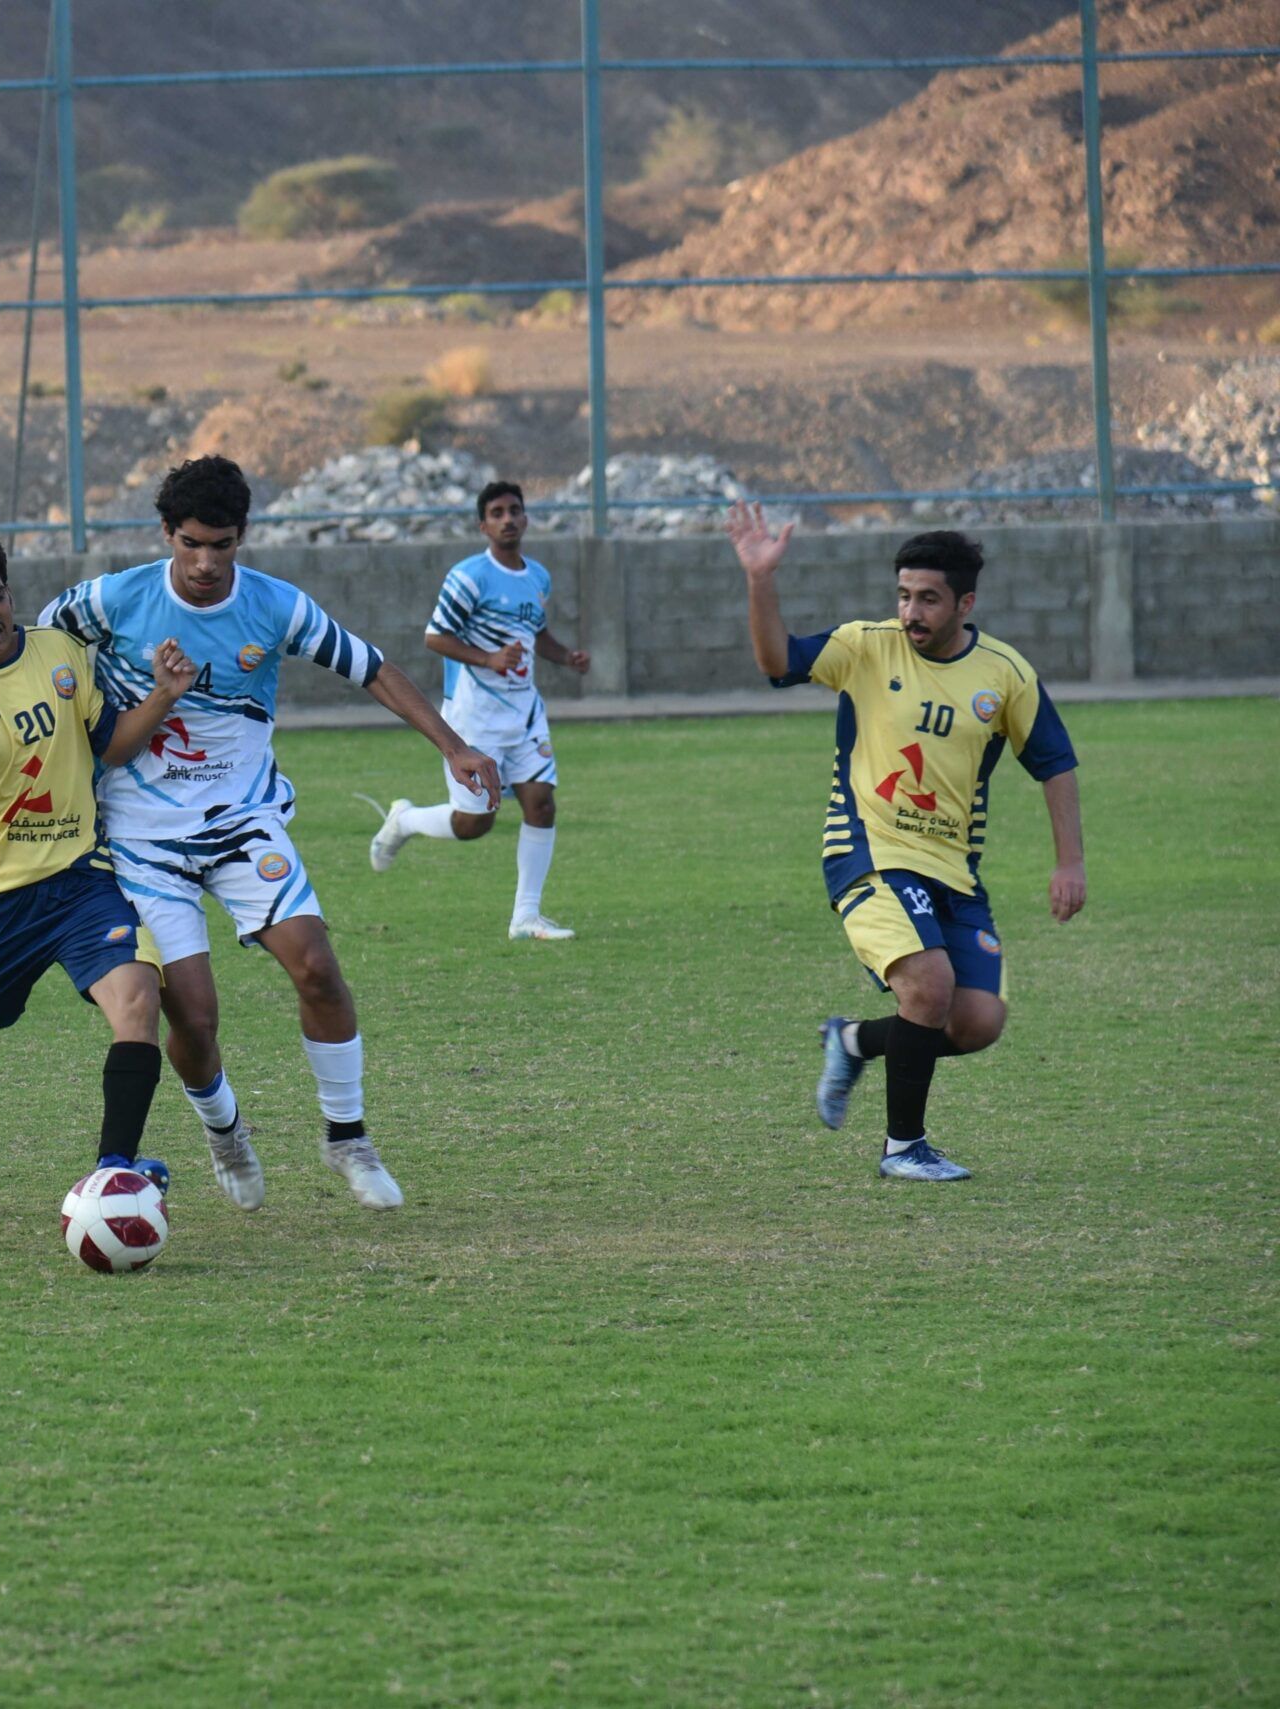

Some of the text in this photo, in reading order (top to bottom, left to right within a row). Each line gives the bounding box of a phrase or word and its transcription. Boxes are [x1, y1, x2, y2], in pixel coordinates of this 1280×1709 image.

[187, 662, 214, 692] 4
[14, 701, 56, 746] 20
[914, 700, 955, 738] 10
[7, 829, 37, 842] bank
[895, 818, 926, 834] bank
